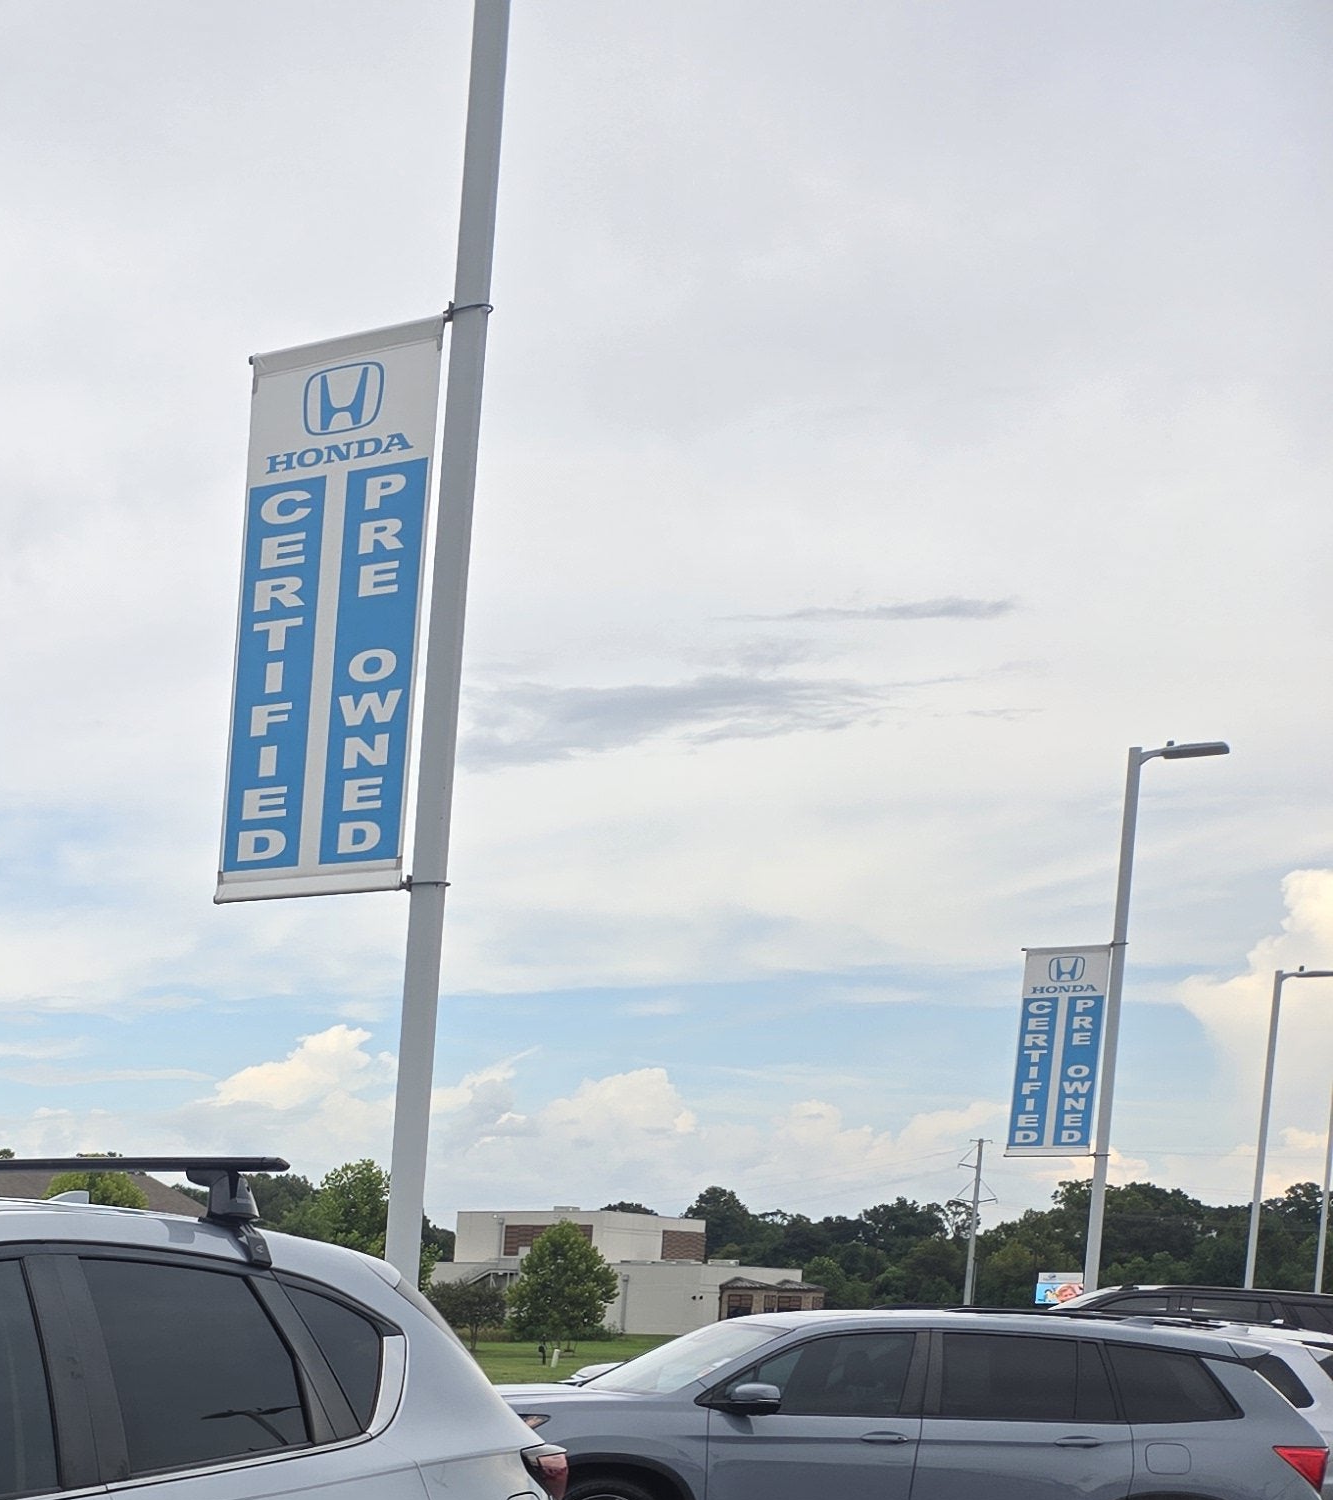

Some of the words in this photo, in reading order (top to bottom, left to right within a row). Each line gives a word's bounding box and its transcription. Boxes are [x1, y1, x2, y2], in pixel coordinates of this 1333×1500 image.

[265, 432, 414, 475] HONDA
[357, 473, 407, 598] PRE
[236, 490, 312, 863] CERTIFIED
[337, 648, 403, 854] OWNED
[1030, 984, 1098, 995] HONDA
[1071, 999, 1095, 1046] PRE
[1014, 1000, 1053, 1144] CERTIFIED
[1060, 1064, 1092, 1144] OWNED
